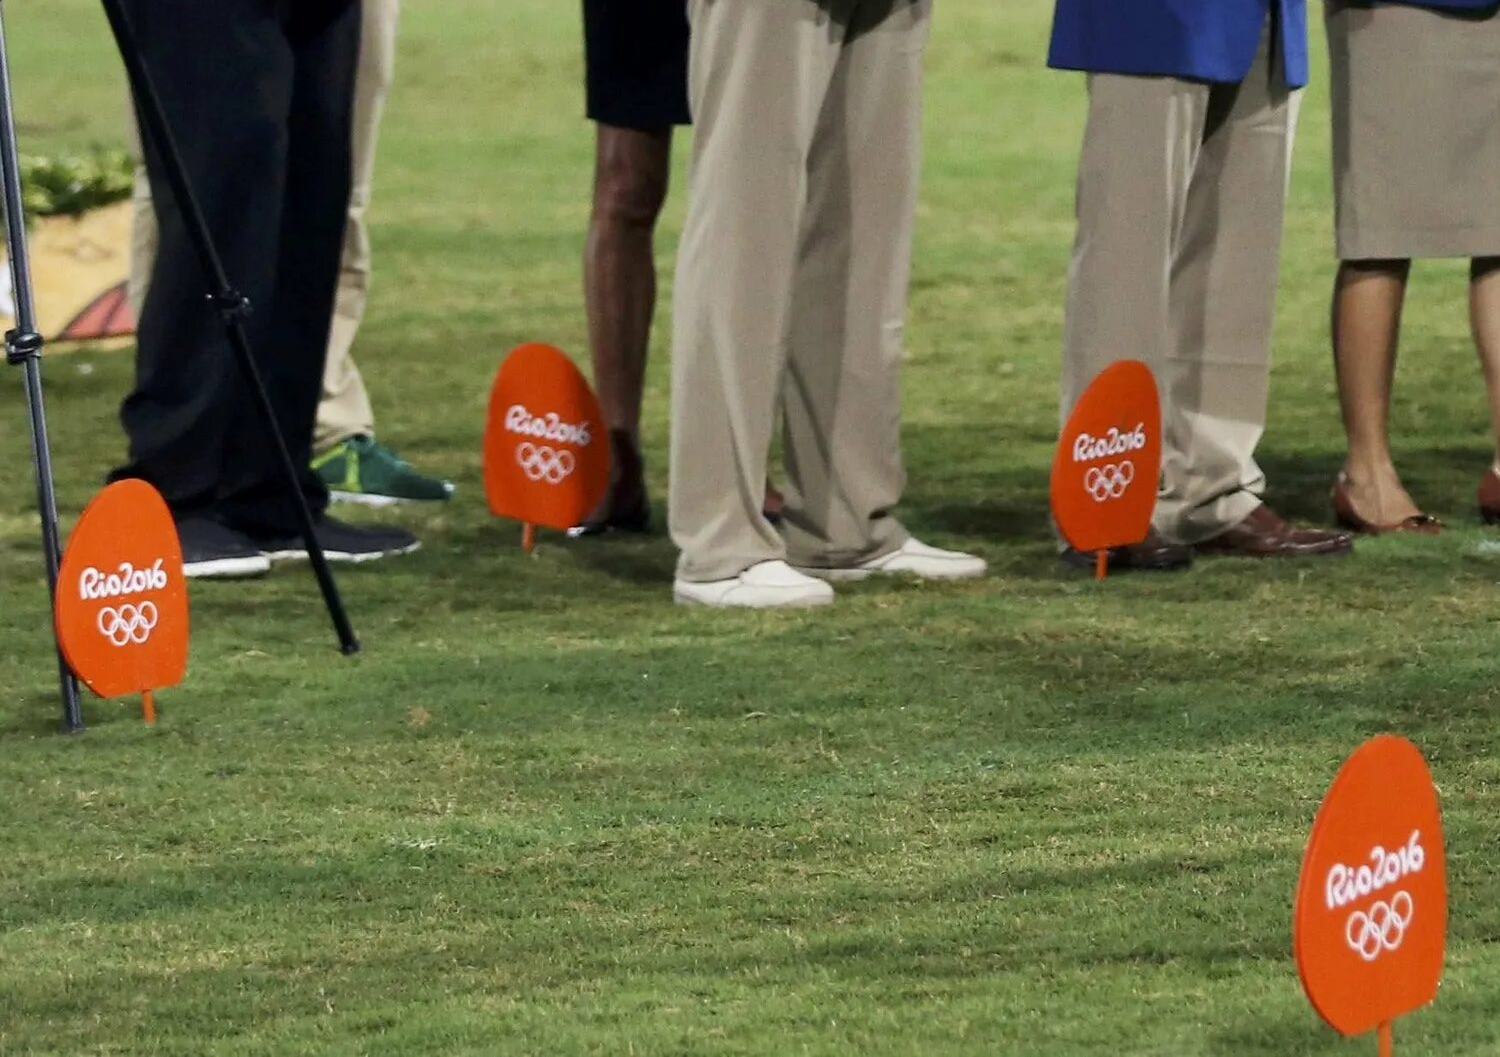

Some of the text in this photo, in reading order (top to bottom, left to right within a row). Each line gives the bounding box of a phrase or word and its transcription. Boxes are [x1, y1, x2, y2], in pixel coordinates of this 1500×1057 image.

[504, 403, 592, 447] Rio2016
[1072, 422, 1147, 463] Rio2016
[79, 557, 168, 600] Rio2016
[1325, 828, 1426, 910] Rio2016
